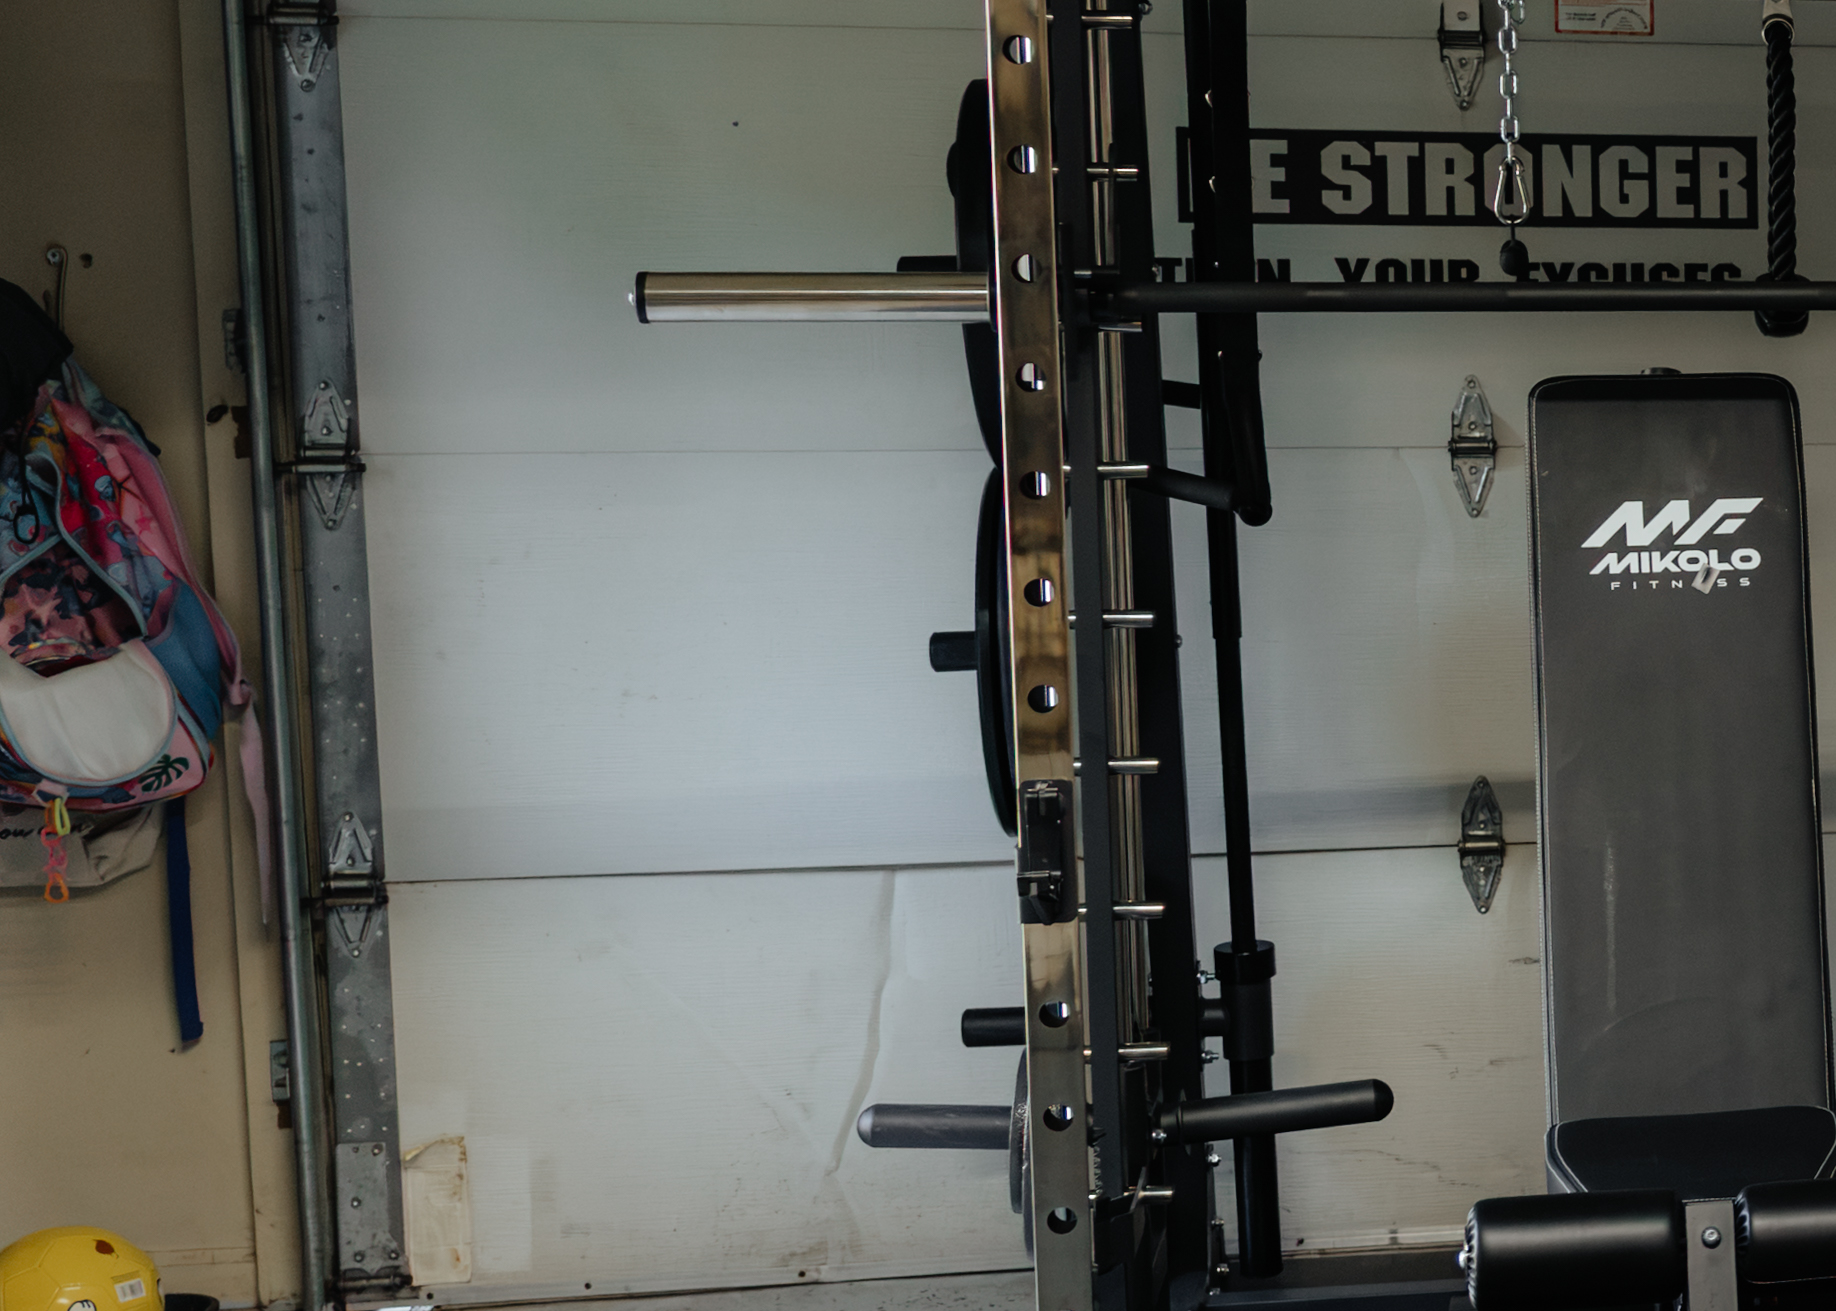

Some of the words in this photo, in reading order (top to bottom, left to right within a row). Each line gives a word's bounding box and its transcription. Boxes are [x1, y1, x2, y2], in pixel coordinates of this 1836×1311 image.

[1320, 140, 1748, 219] STRONGER
[1589, 548, 1762, 575] MIKOLO
[1610, 577, 1751, 591] FITNSS
